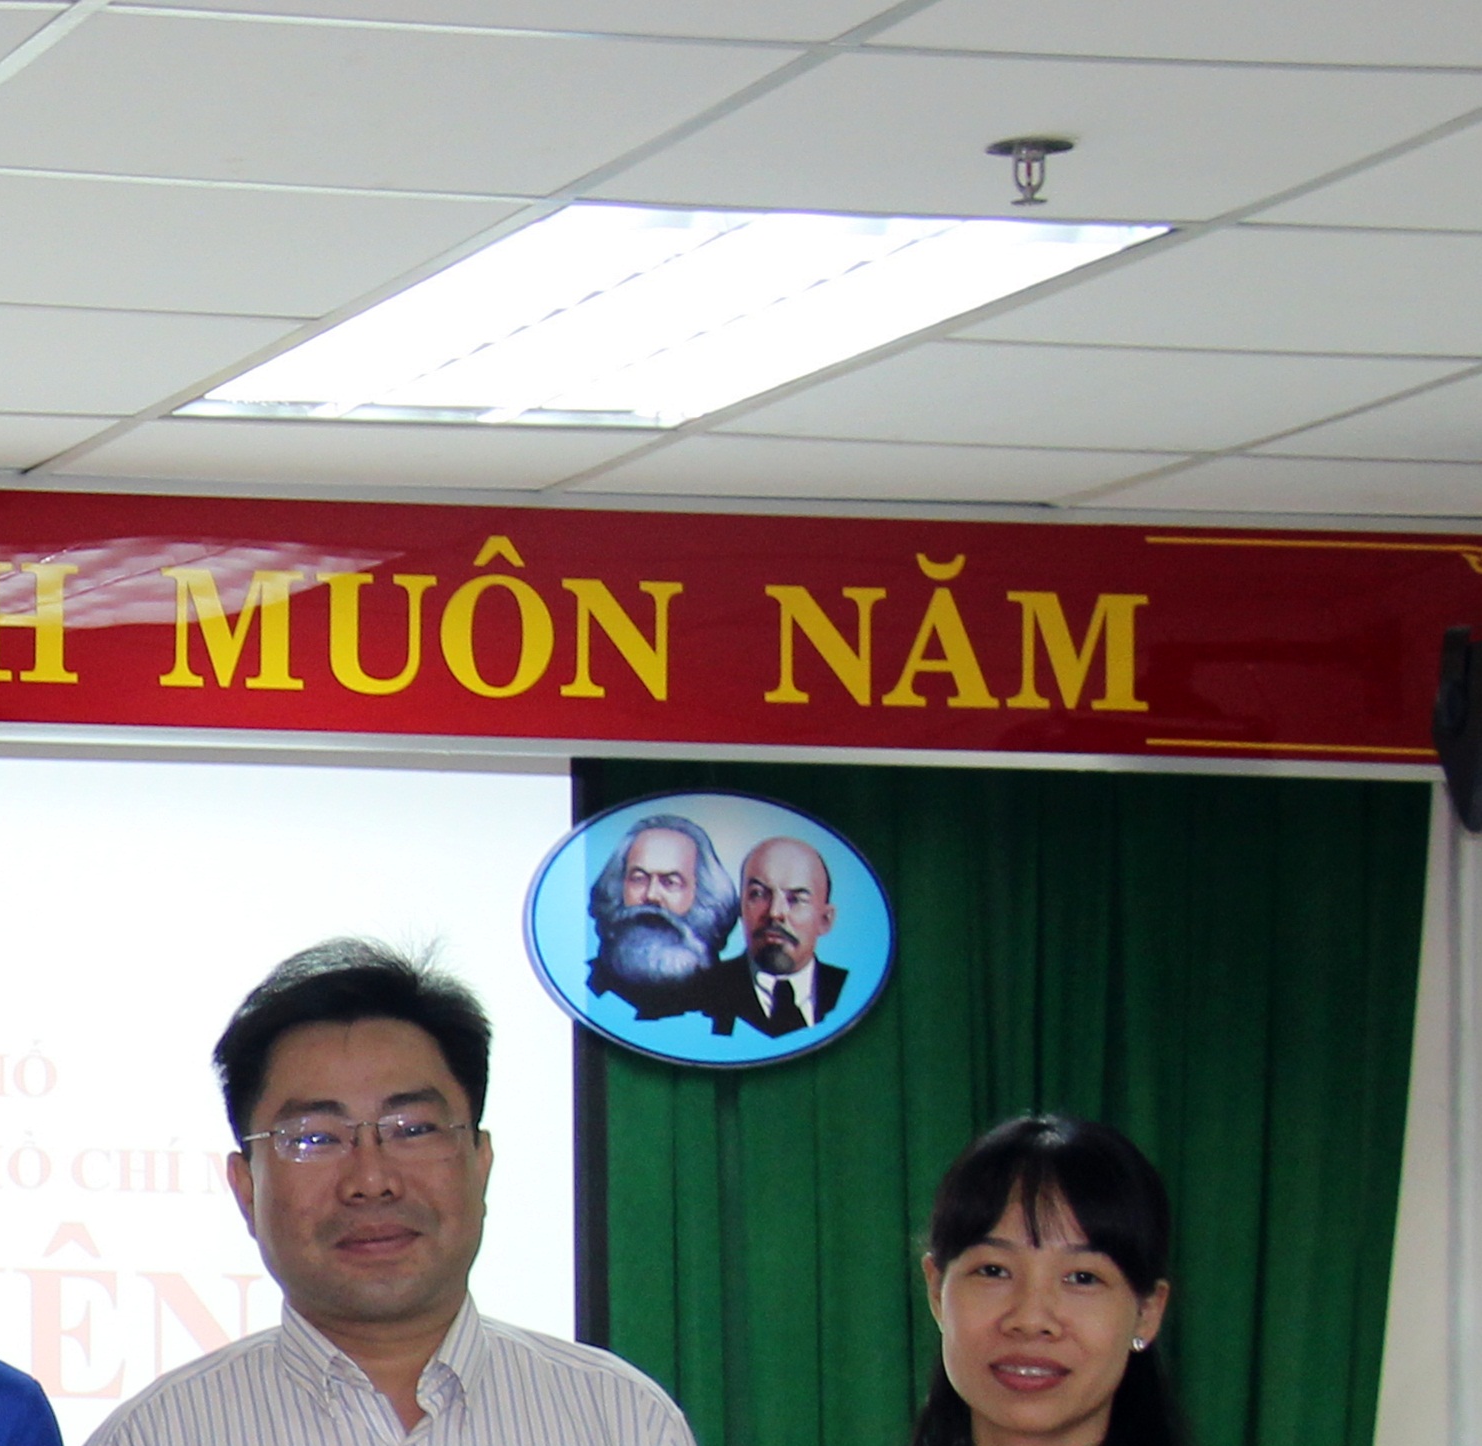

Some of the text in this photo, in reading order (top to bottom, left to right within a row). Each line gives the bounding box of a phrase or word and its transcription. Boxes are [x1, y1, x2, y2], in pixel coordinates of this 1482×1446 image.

[158, 535, 683, 703] MUÔN
[763, 553, 1150, 713] NĂM
[70, 1137, 185, 1195] CHÍ
